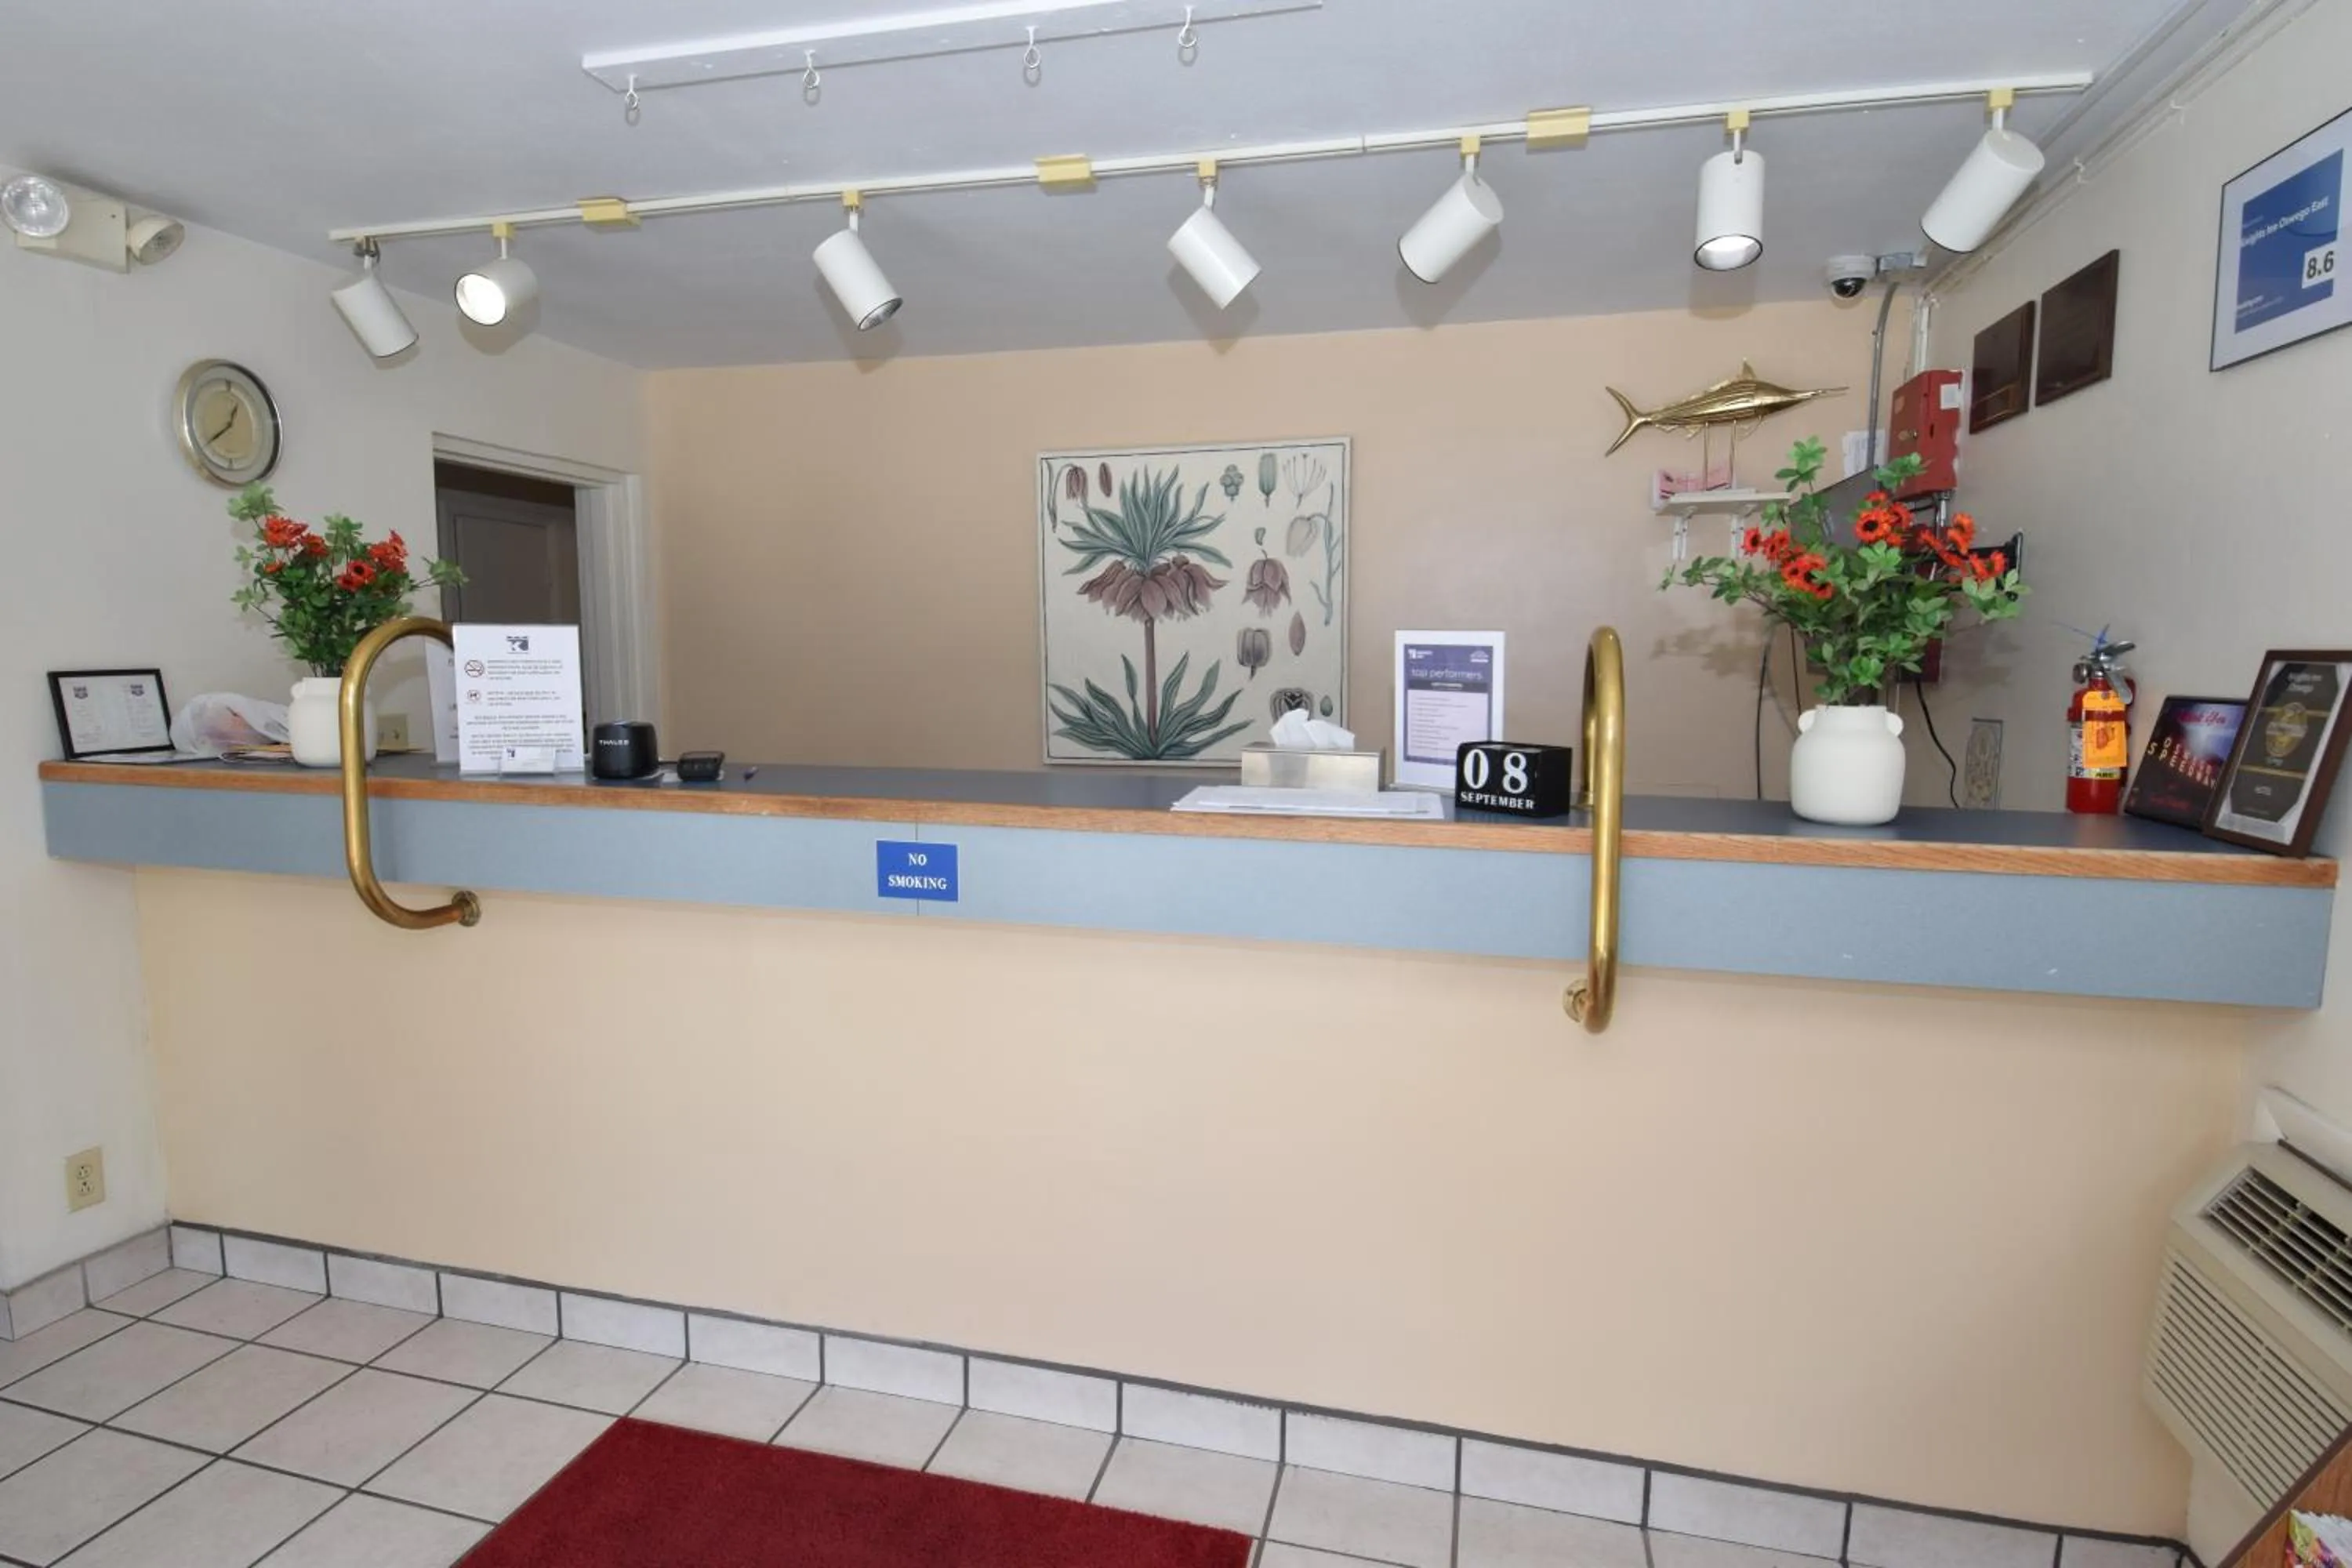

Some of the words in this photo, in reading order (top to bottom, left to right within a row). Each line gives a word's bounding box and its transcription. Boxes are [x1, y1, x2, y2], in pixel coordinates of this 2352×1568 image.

[2307, 250, 2334, 279] 8.6
[1411, 668, 1428, 678] top
[1429, 668, 1483, 681] performers
[1461, 791, 1534, 810] SEPTEMBER
[908, 852, 927, 866] NO
[887, 874, 948, 890] SMOKING
